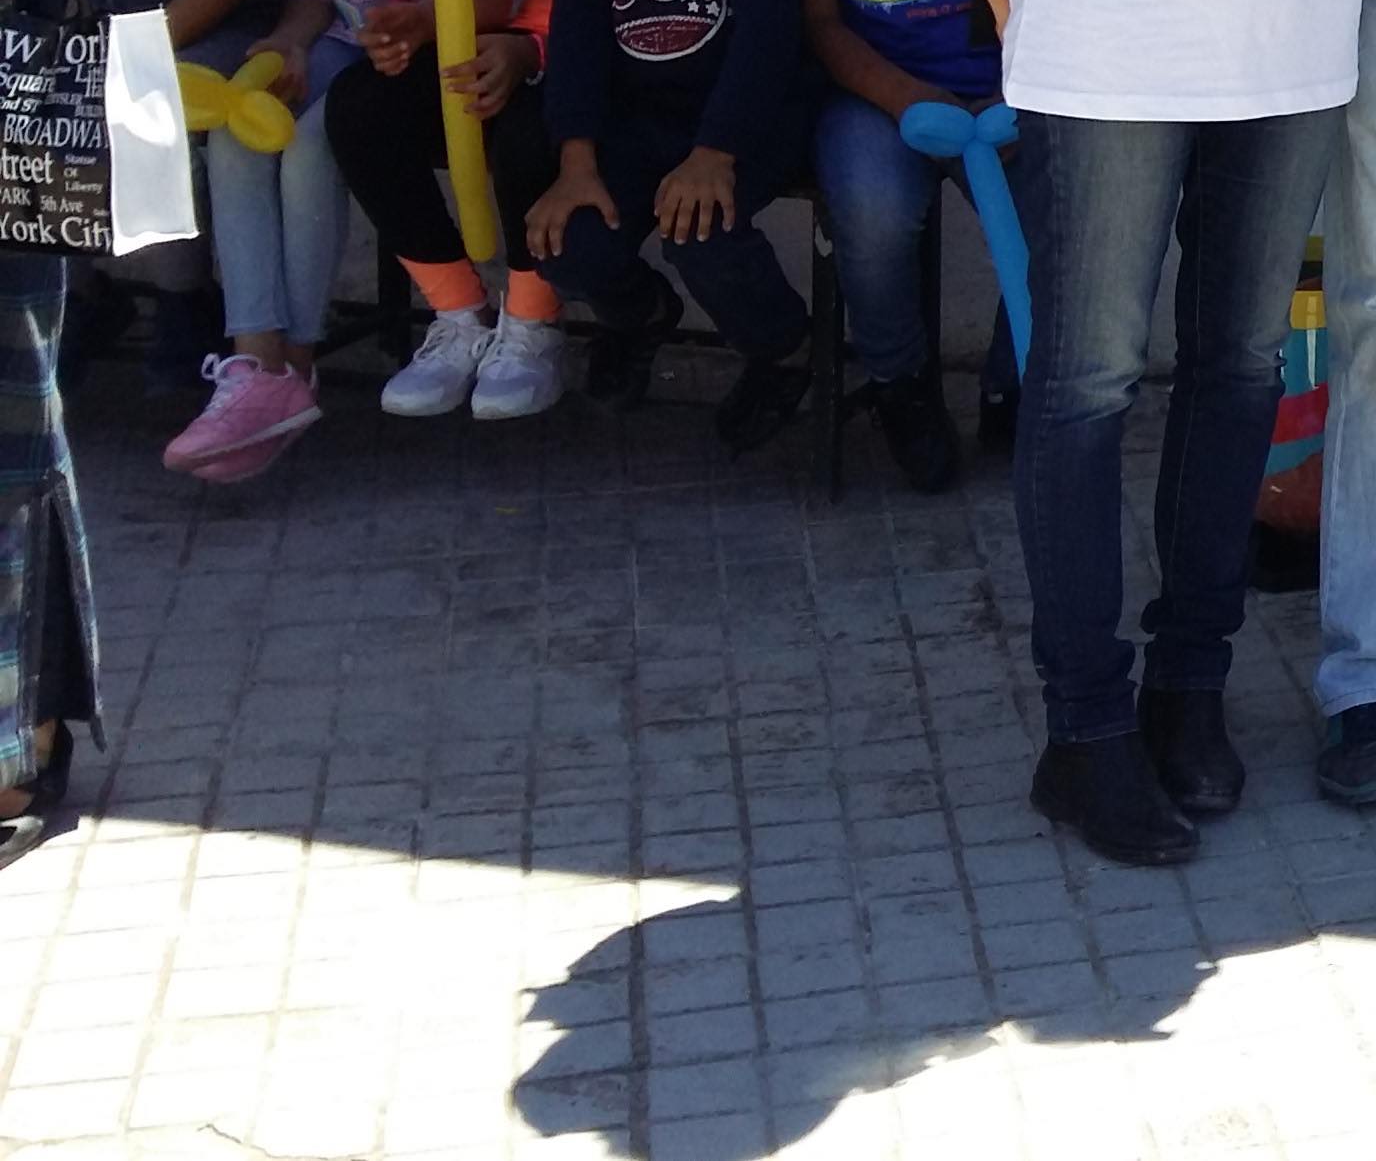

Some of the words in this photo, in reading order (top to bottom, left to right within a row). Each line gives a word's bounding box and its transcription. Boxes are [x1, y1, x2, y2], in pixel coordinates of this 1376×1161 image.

[0, 147, 55, 185] treet
[0, 186, 31, 206] ARK
[59, 196, 85, 214] Ave
